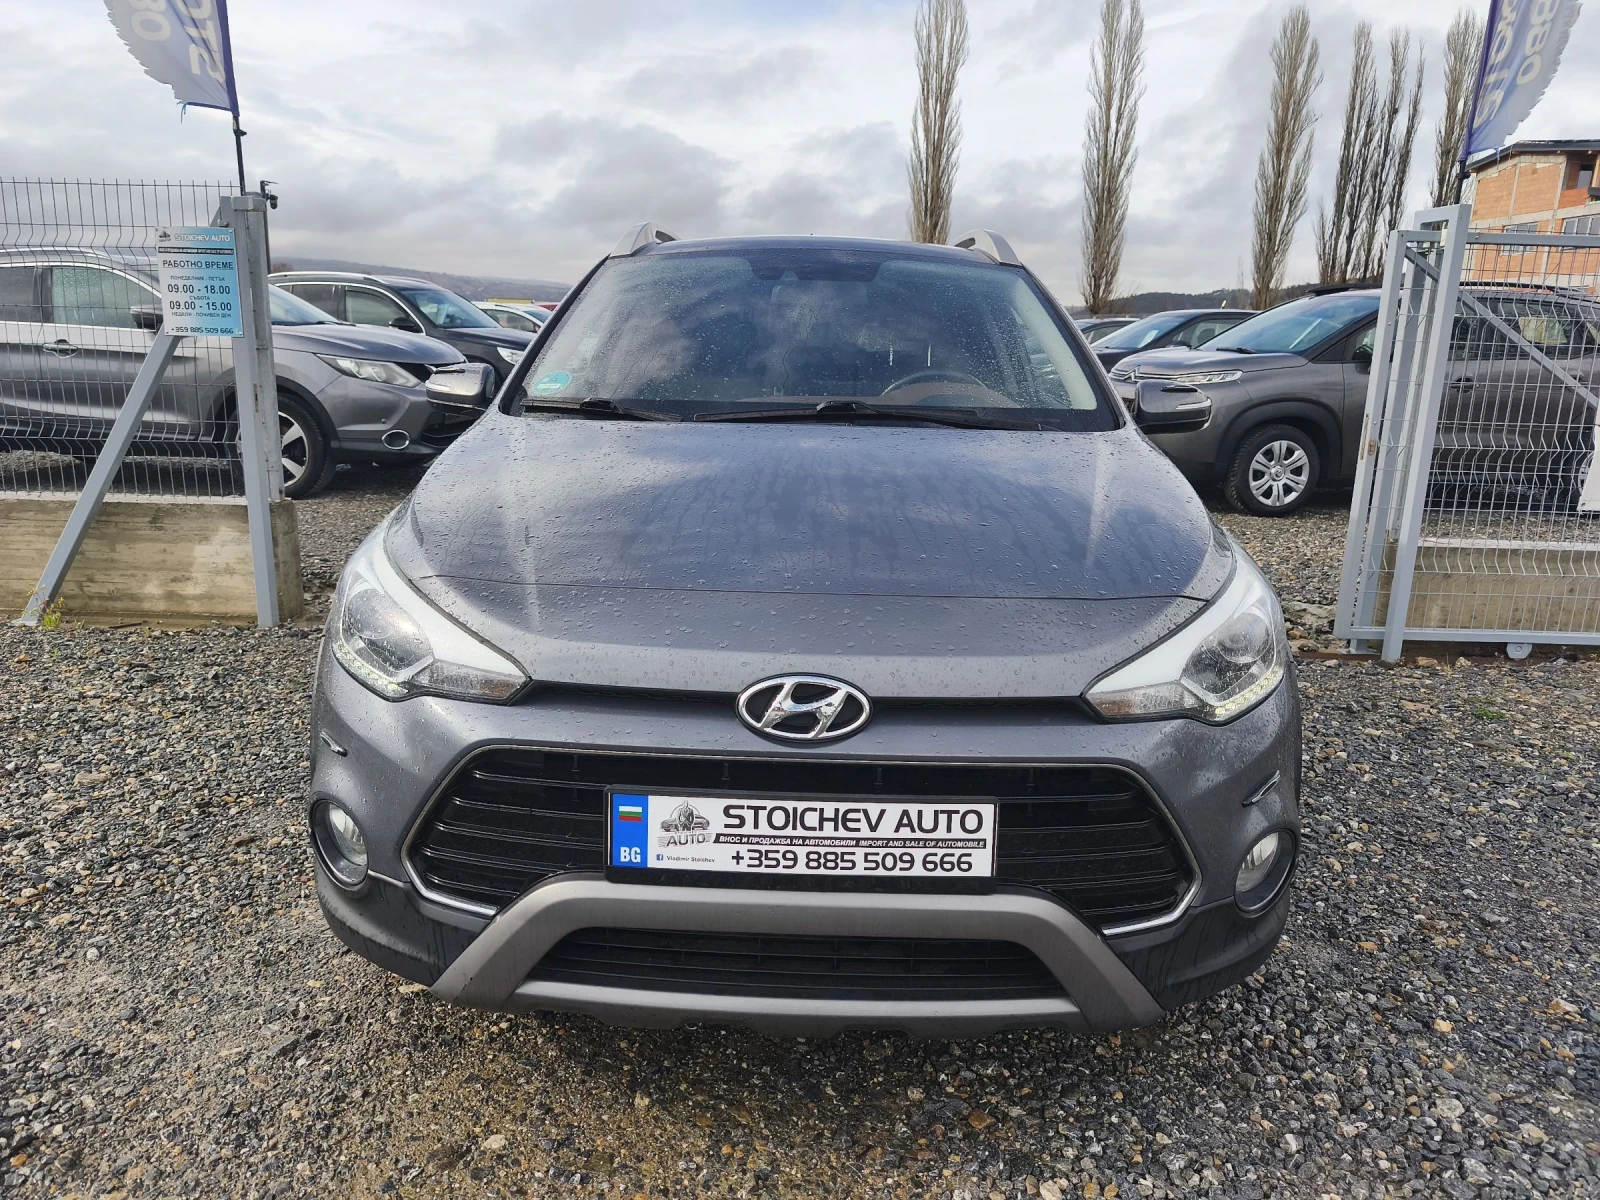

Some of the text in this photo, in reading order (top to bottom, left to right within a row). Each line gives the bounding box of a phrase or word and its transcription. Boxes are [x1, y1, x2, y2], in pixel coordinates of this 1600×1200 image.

[174, 233, 209, 242] STOICHEV
[211, 234, 231, 242] AUTO
[162, 259, 234, 269] РАБОТНО ВРЕМЕ
[167, 284, 195, 294] 09.00
[204, 285, 231, 295] 18.00
[169, 301, 196, 310] 09.00
[205, 302, 232, 311] 15.00
[723, 804, 984, 835] STOICHEV AUTO
[666, 833, 706, 847] AUTO
[719, 835, 741, 844] ВНОС
[741, 836, 748, 844] И
[749, 837, 791, 846] ПРОДАЖБА
[804, 838, 857, 847] АВТОМОБИЛИ
[858, 840, 888, 848] IMPORT
[887, 840, 905, 848] AND
[937, 841, 985, 849] AUTOMOBILE
[620, 847, 641, 863] BG
[731, 849, 973, 873] +359 885 509 666
